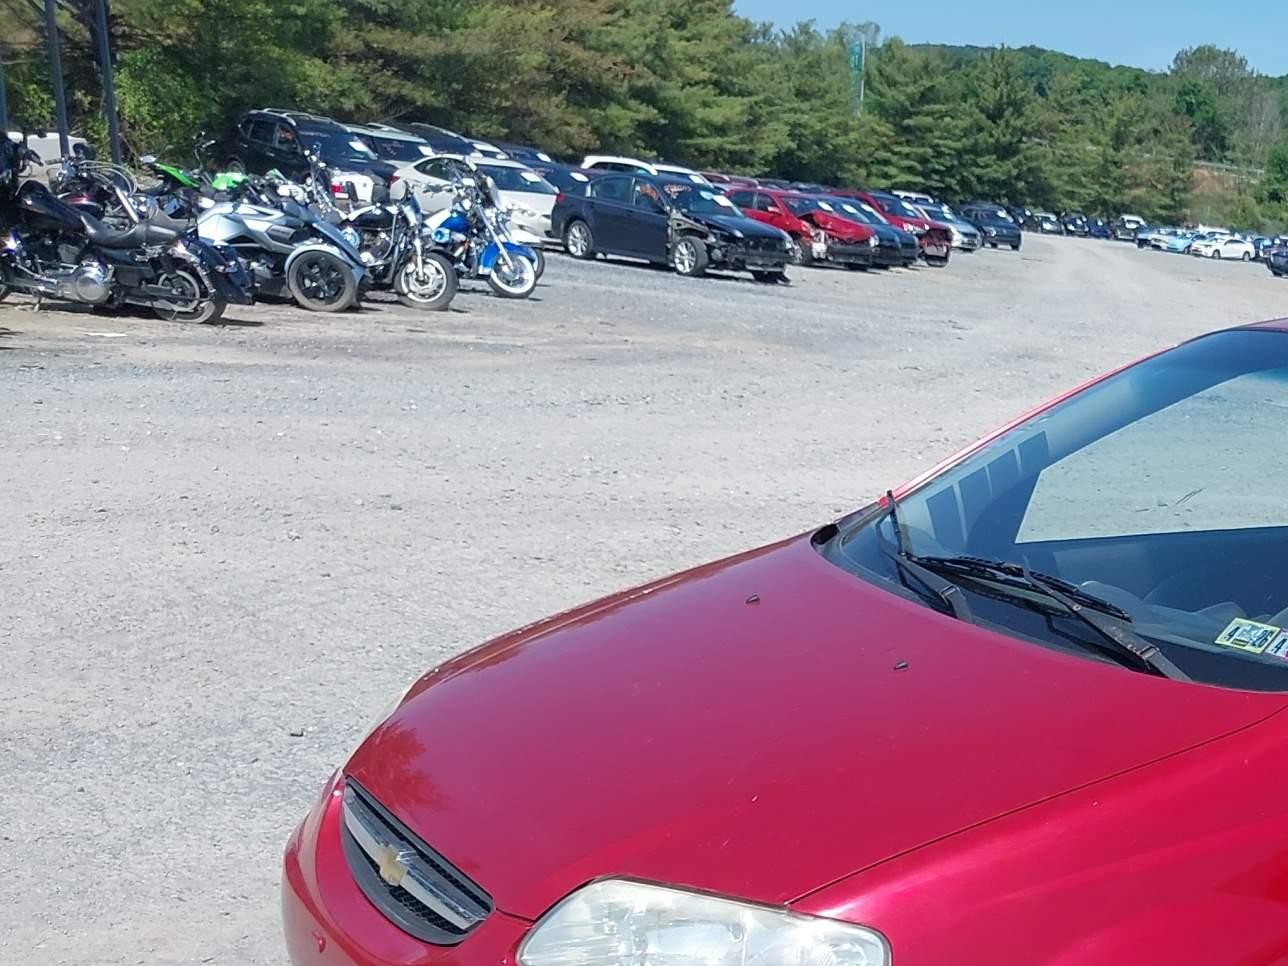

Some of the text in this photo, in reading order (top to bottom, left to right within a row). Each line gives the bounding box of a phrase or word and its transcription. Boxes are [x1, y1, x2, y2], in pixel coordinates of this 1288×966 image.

[1224, 626, 1274, 649] 4 26
[1272, 637, 1288, 654] 4
